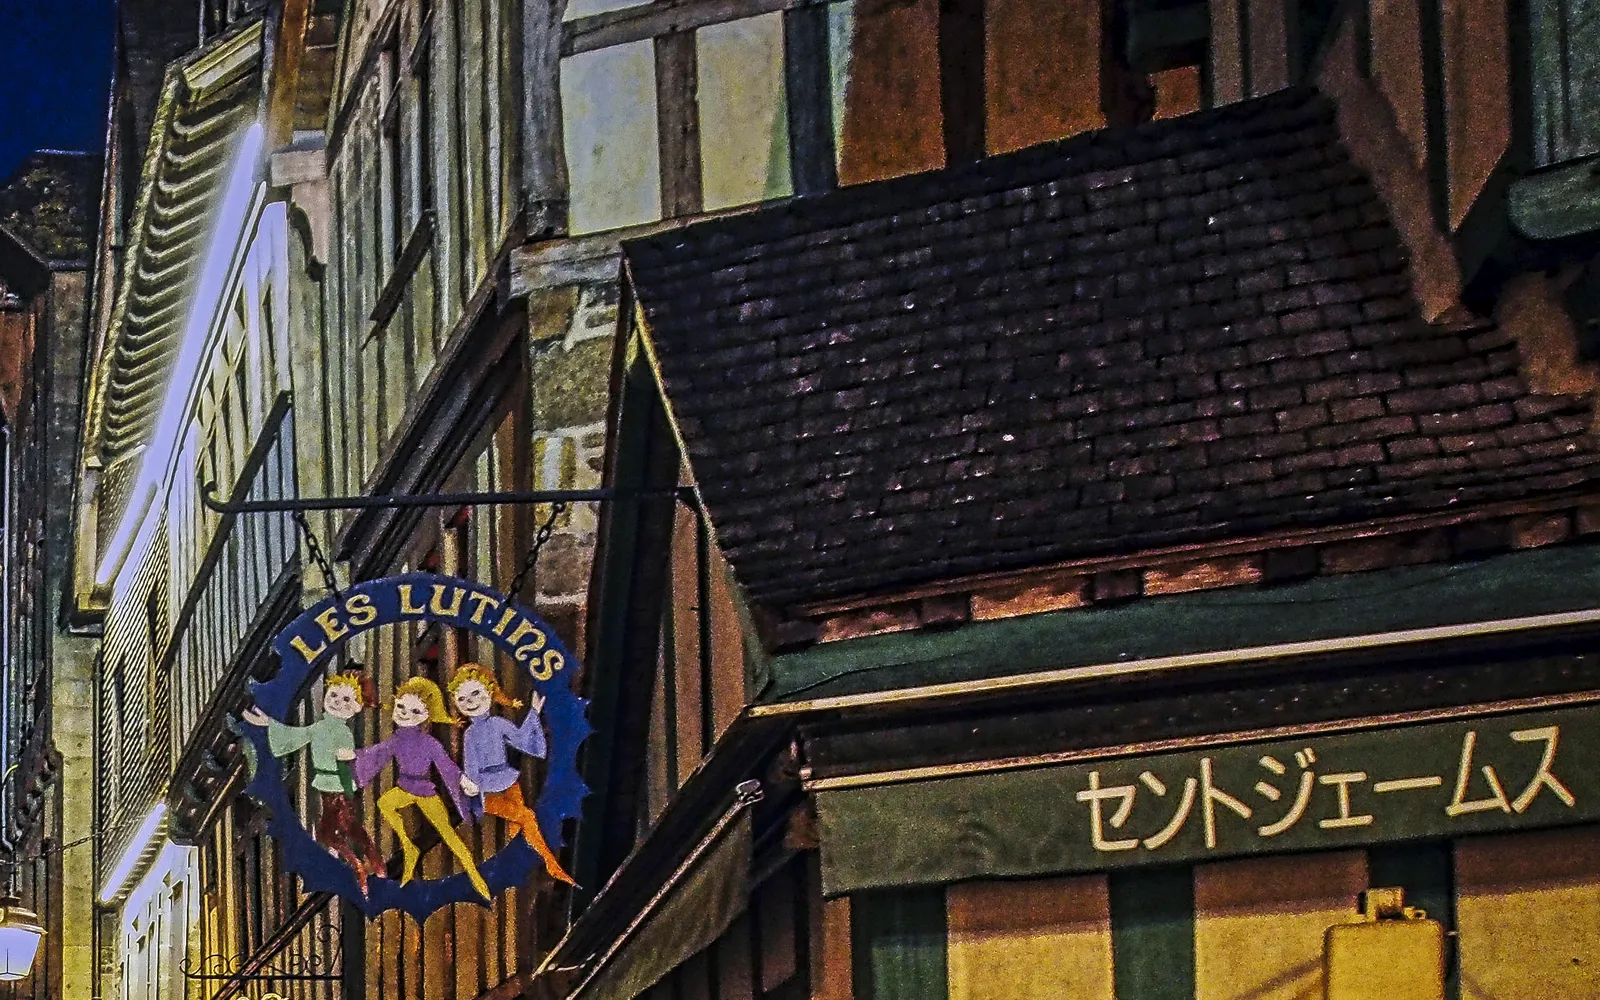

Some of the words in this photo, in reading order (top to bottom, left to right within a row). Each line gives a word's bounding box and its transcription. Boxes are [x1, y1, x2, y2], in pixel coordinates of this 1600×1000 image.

[289, 593, 378, 665] LES
[397, 583, 566, 681] LUTINS
[1075, 725, 1577, 852] セントジェームス
